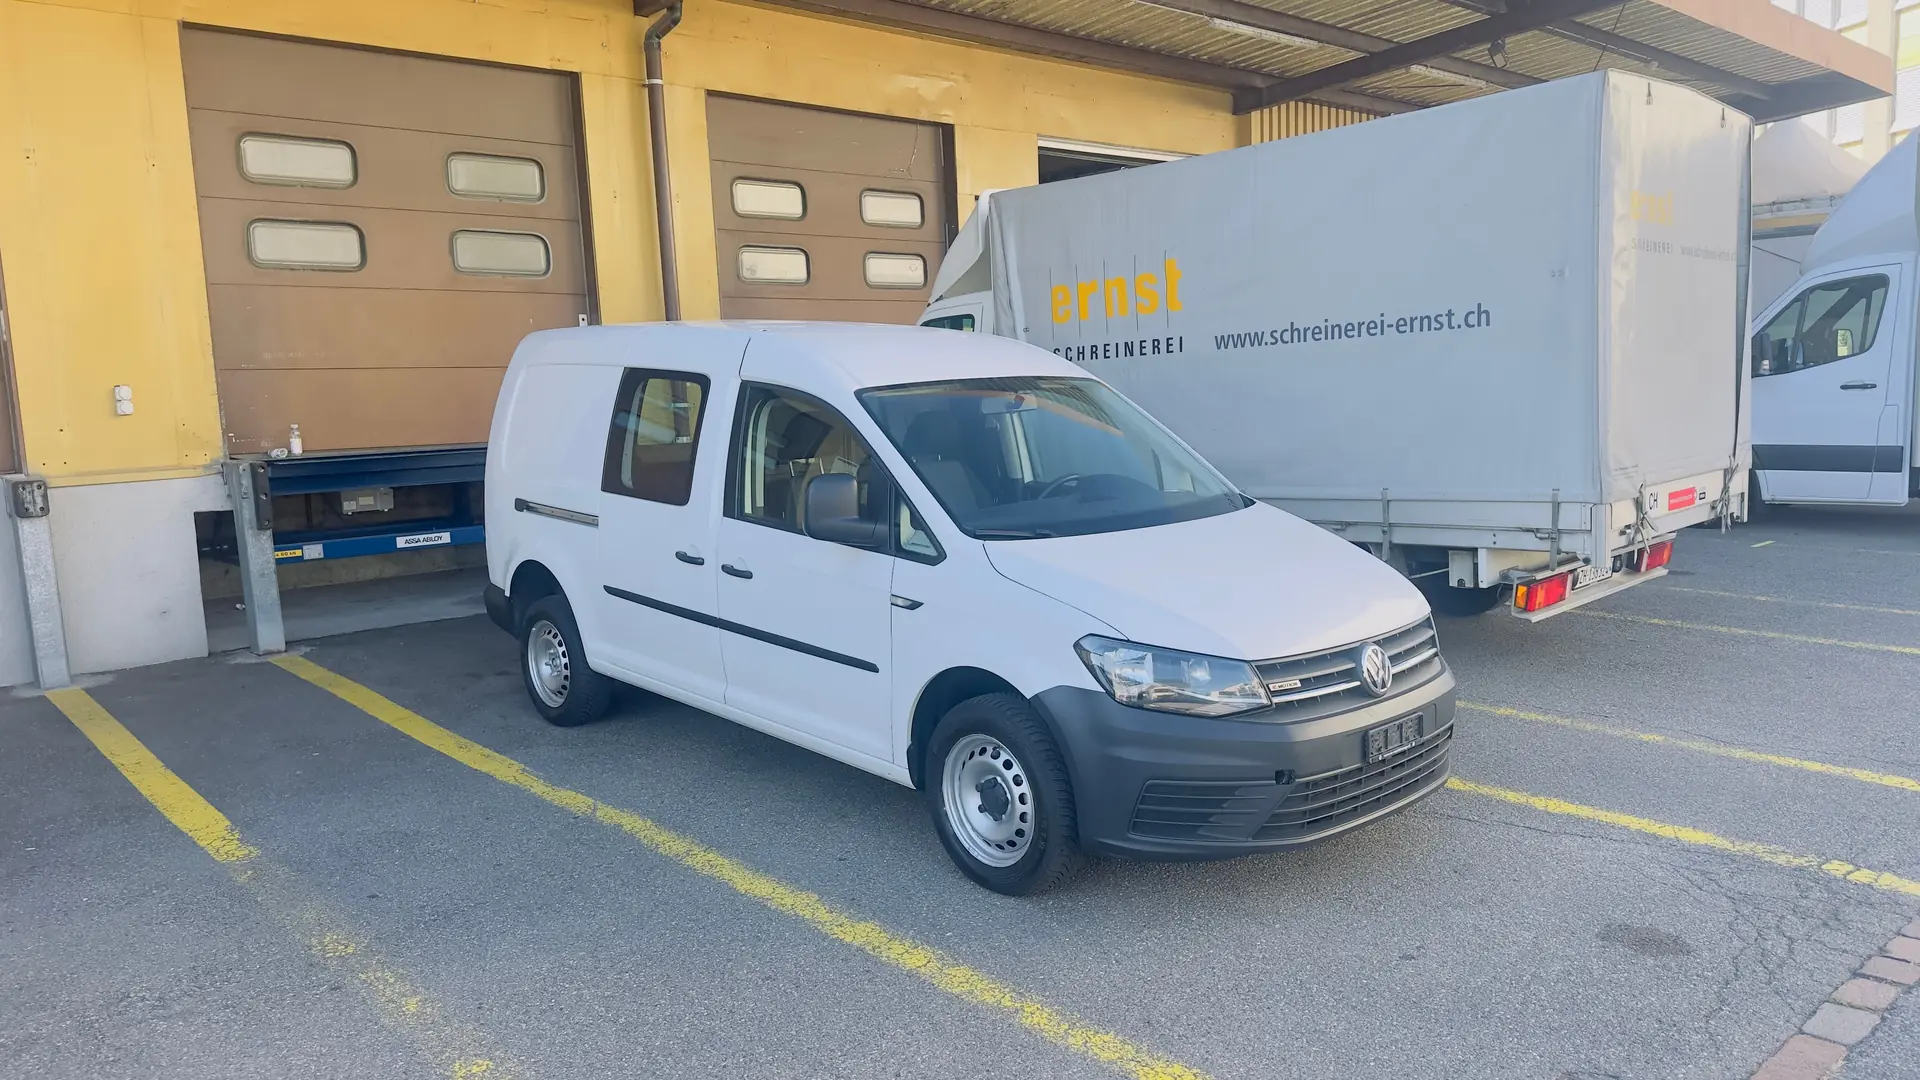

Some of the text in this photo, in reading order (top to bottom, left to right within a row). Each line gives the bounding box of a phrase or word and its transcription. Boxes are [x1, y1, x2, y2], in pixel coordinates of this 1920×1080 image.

[1051, 258, 1183, 324] ernst
[1214, 303, 1491, 350] www.schreinerei-ernst.ch
[1649, 492, 1658, 510] CH
[422, 535, 443, 543] ABLOY
